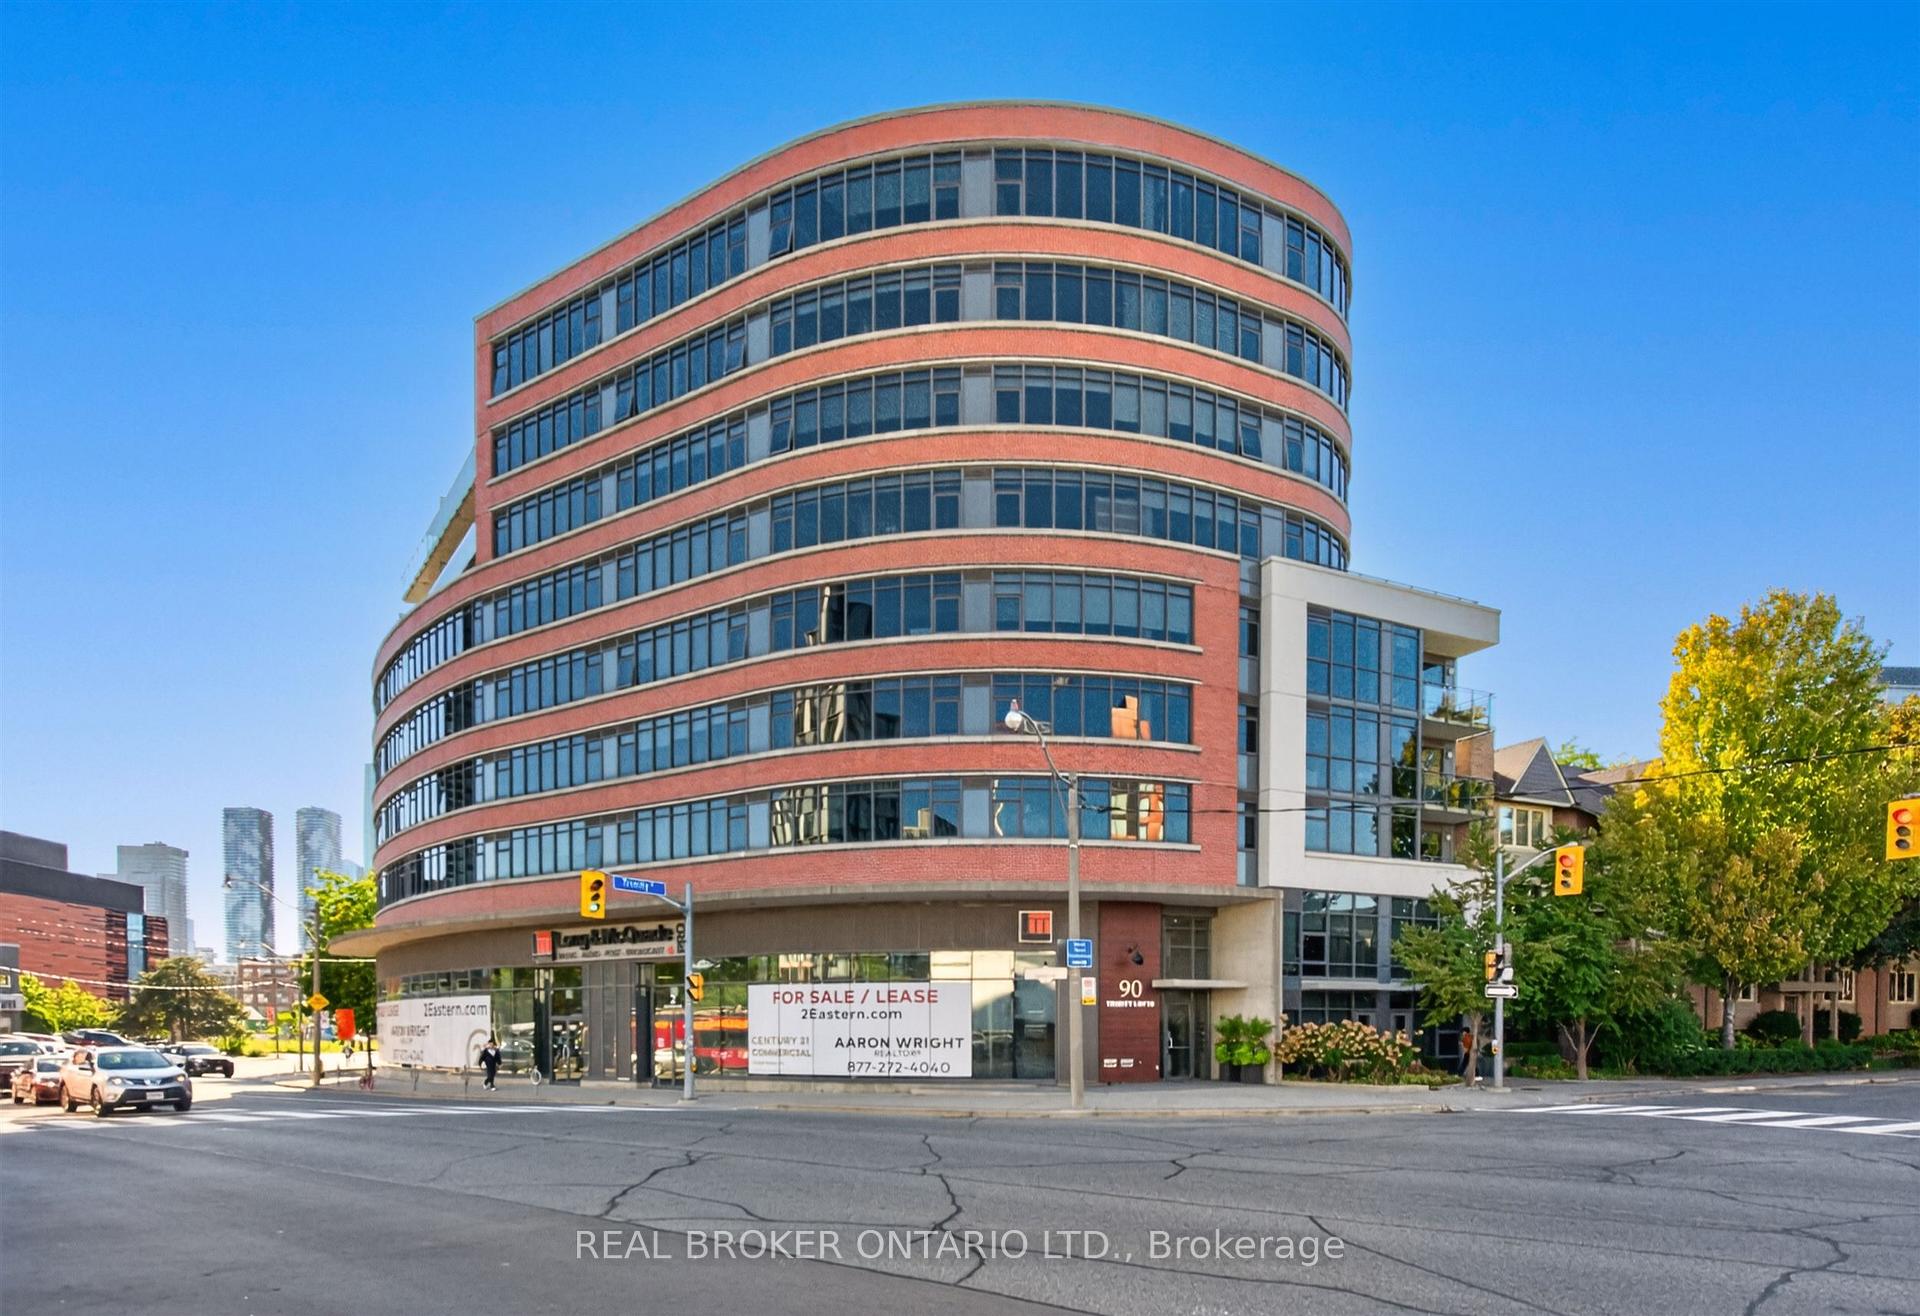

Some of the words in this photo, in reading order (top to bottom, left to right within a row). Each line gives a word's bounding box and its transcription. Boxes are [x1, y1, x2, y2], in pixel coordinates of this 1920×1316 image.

[1119, 979, 1143, 998] 90
[773, 991, 804, 1004] FOR
[811, 990, 854, 1004] SALE
[860, 989, 870, 1004] /
[876, 989, 938, 1004] LEASE
[801, 1008, 902, 1020] 2Eastern.com
[752, 1036, 797, 1045] CENTURY
[835, 1037, 890, 1049] AARON
[896, 1037, 964, 1049] WRIGHT
[847, 1061, 951, 1073] 877-272-4040
